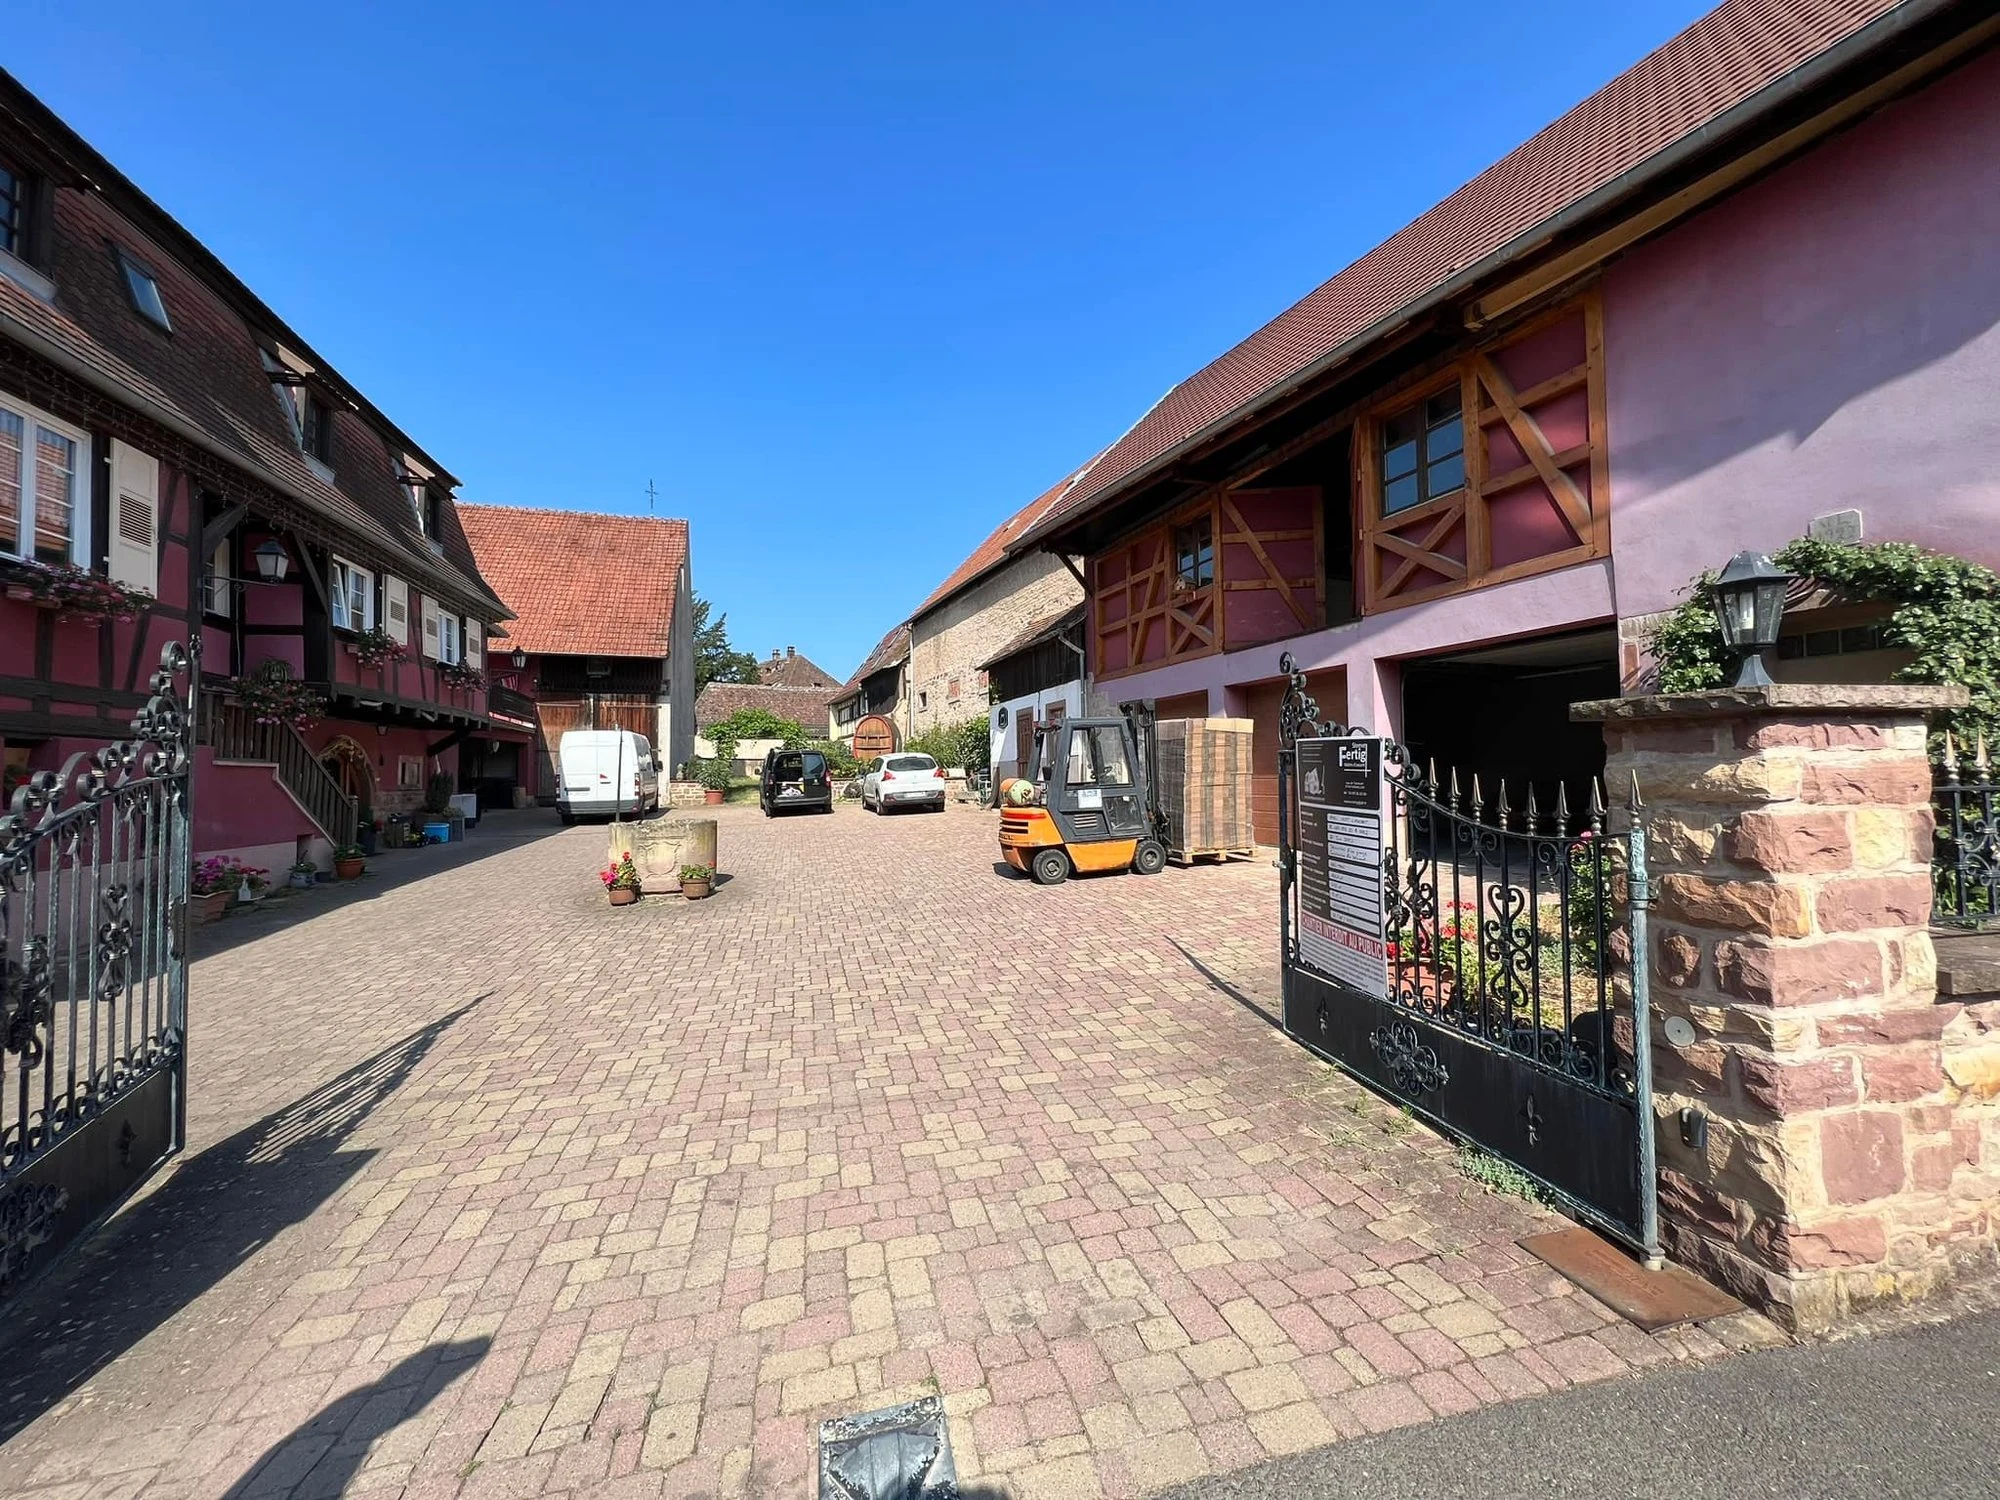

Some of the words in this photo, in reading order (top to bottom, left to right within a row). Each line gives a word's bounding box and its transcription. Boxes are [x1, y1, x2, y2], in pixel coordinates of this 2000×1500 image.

[1339, 746, 1367, 767] Fertig
[1350, 935, 1360, 950] AU
[1360, 938, 1383, 960] PUBLIC
